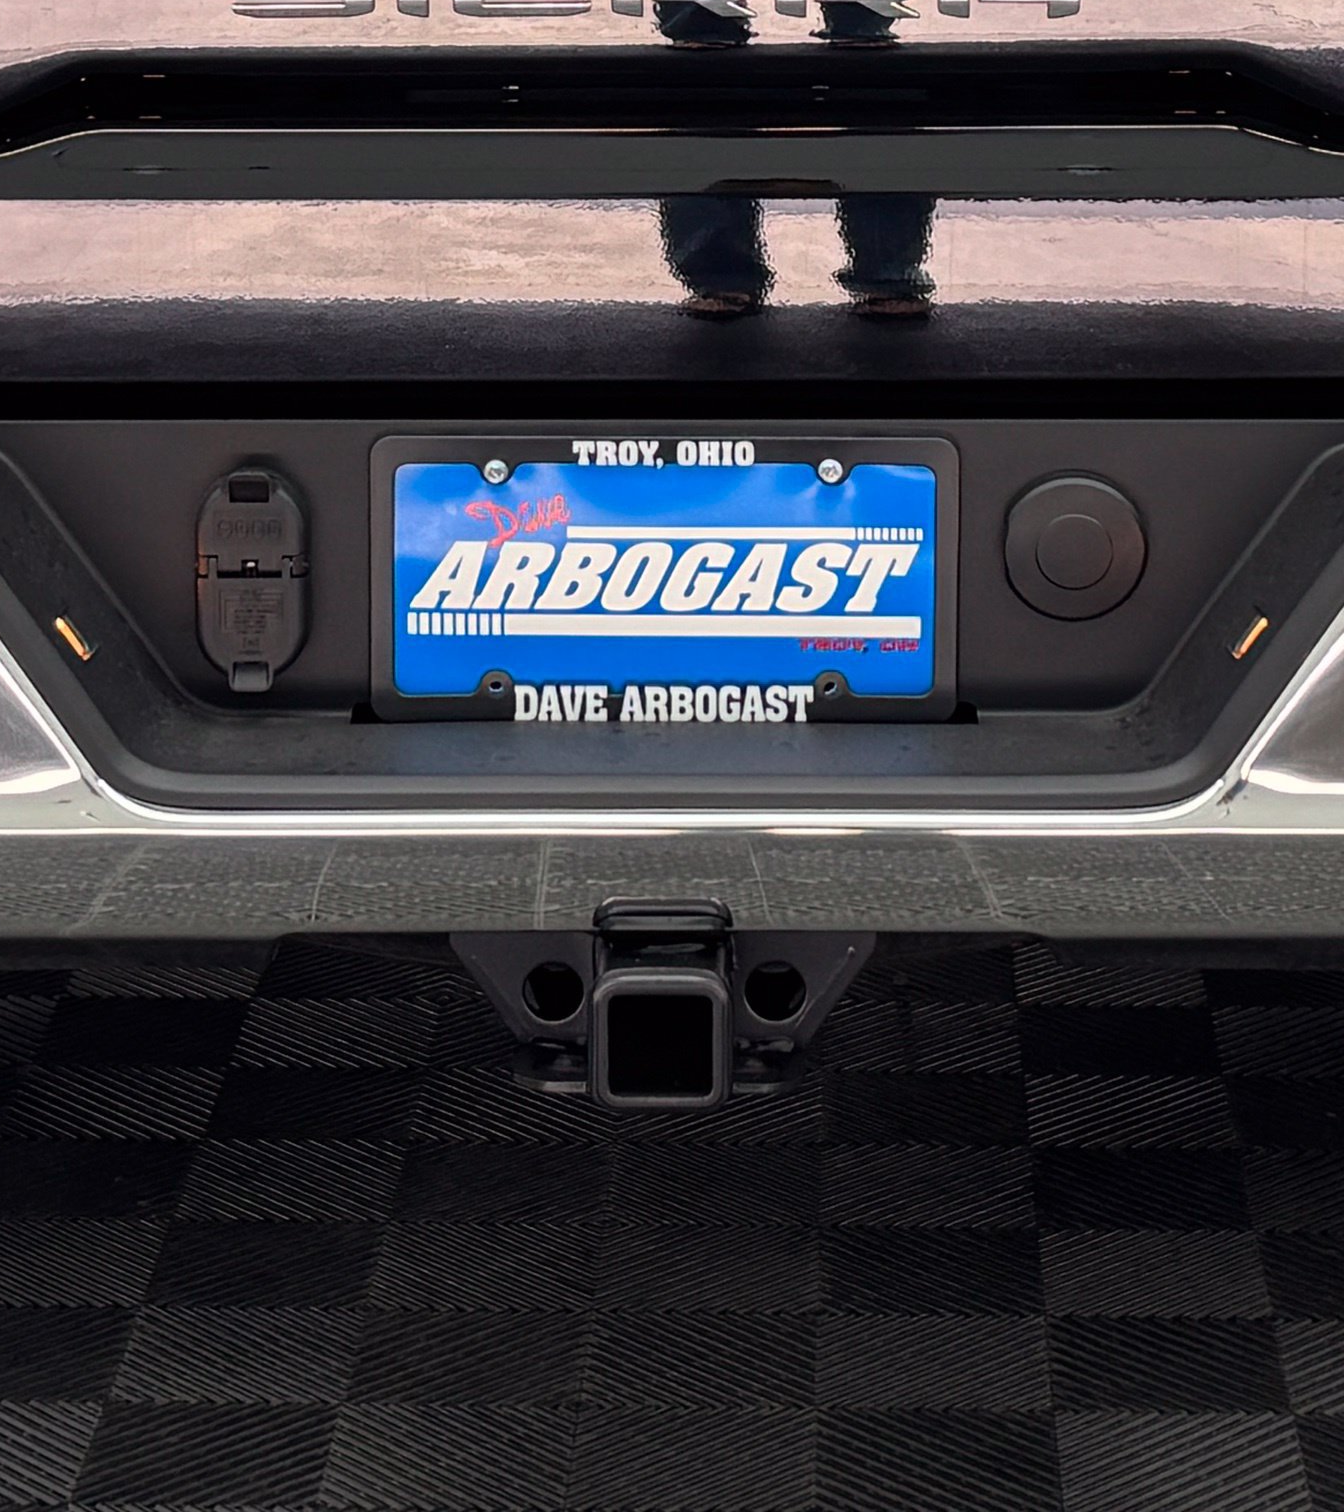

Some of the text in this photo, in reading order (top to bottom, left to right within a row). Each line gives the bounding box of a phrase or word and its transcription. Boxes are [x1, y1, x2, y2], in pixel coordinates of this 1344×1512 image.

[572, 440, 755, 470] TROY, OHIO
[409, 541, 920, 613] ARBOGAST
[513, 684, 815, 723] DAVE ARBOGAST
